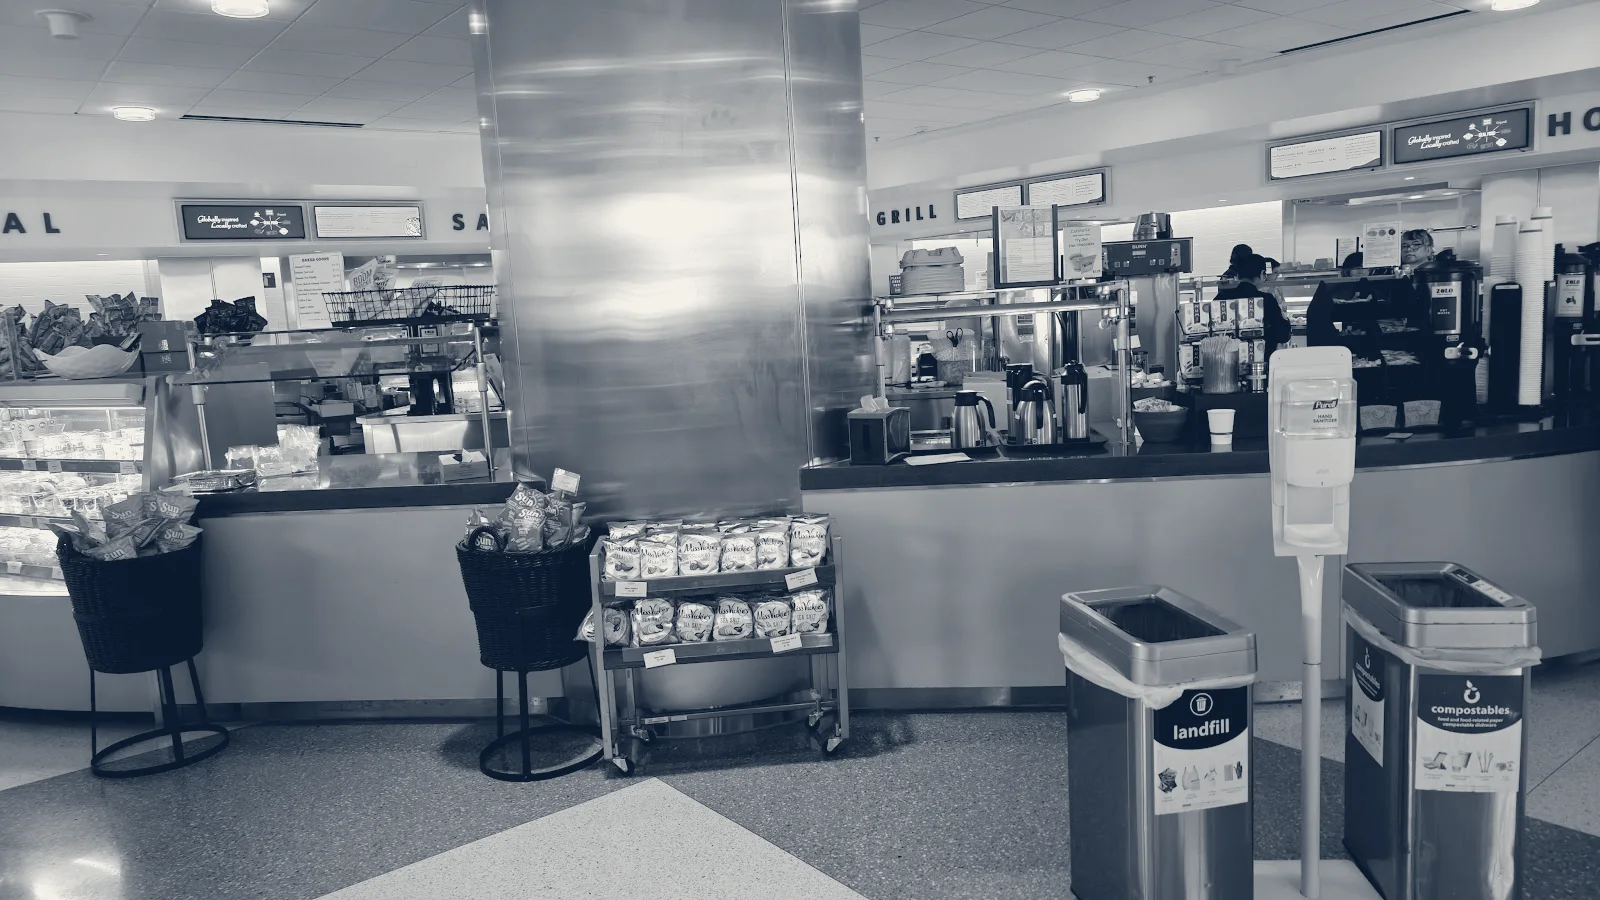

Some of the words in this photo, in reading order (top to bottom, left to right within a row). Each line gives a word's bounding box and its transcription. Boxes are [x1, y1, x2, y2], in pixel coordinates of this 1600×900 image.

[1408, 134, 1432, 146] Globally
[1420, 140, 1442, 150] Locally
[1442, 138, 1460, 146] crafted
[197, 215, 221, 224] Globally
[876, 204, 937, 226] GRILL
[211, 222, 232, 230] Locally
[1314, 400, 1337, 409] Purell
[514, 492, 534, 507] Sun
[160, 502, 180, 514] Sun
[518, 508, 539, 518] Sun
[164, 528, 183, 540] Sun
[793, 530, 808, 539] Miss
[806, 528, 826, 540] Vickie's
[474, 535, 492, 547] Sun
[684, 544, 700, 553] Miss
[698, 539, 718, 552] Vickie's
[104, 548, 126, 562] Sun
[641, 548, 654, 558] Miss
[653, 548, 674, 558] Vickie's
[732, 544, 754, 554] Vickie's
[635, 608, 651, 616] Miss
[649, 604, 670, 614] Vickie's
[728, 603, 749, 616] Vickie's
[802, 600, 824, 612] Vickie's
[689, 608, 711, 622] Vickie's
[757, 612, 771, 620] Miss
[768, 607, 790, 619] Vickie's
[1431, 705, 1510, 716] compostables
[1173, 718, 1230, 740] landfill
